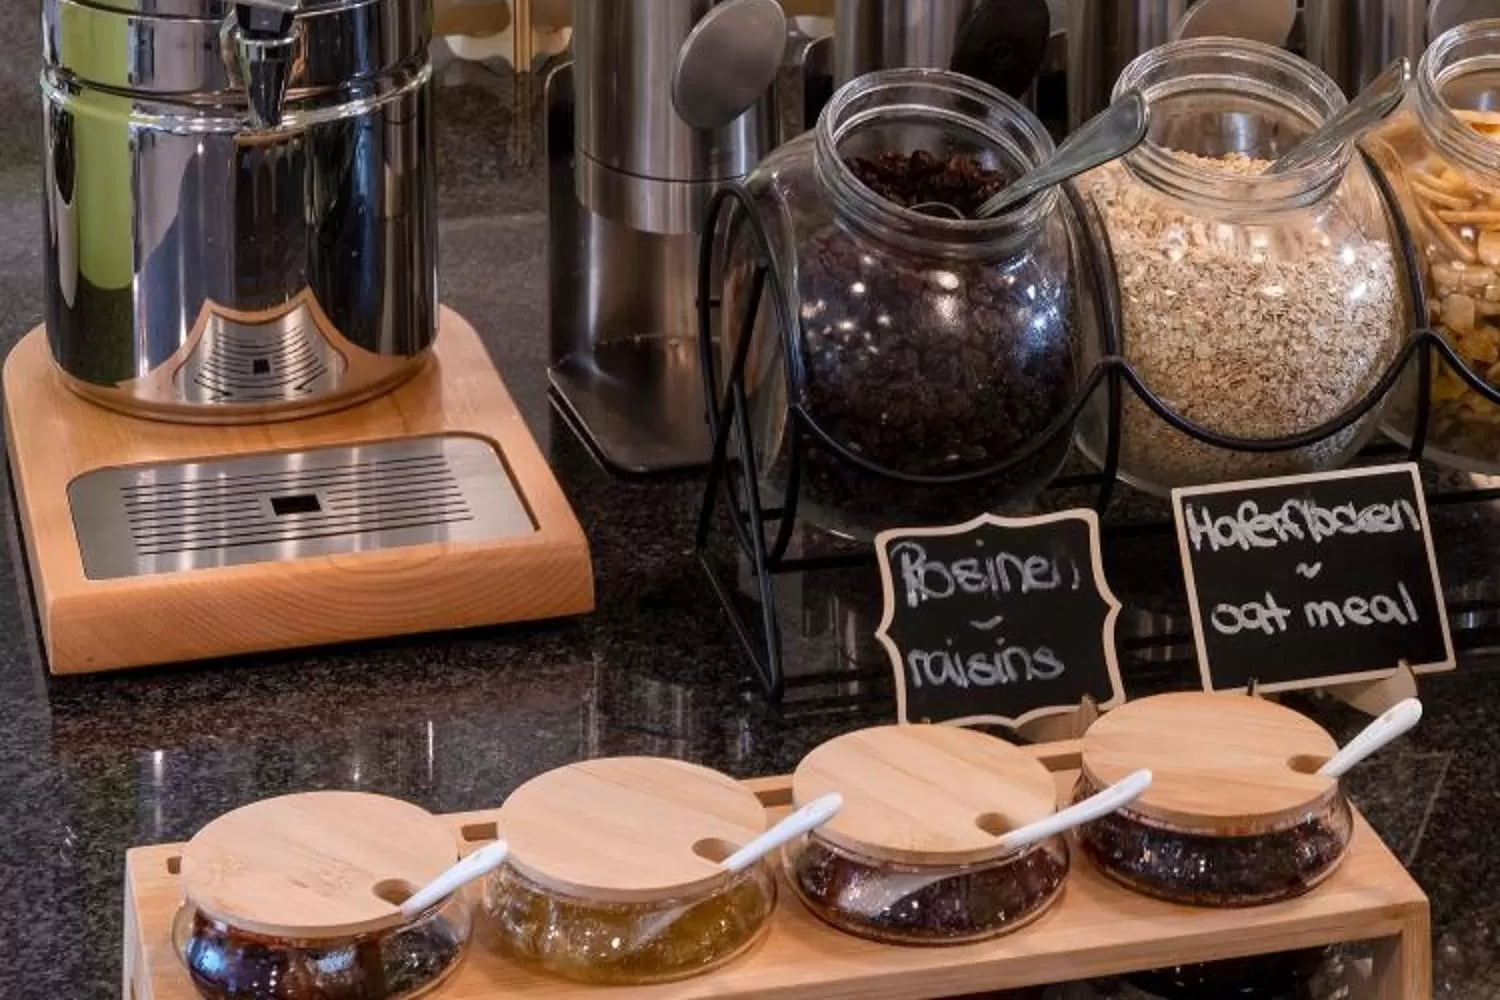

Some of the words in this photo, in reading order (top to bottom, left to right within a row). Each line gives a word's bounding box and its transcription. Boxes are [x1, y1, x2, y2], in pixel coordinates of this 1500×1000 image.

[1211, 591, 1291, 635] oat
[1303, 580, 1418, 627] meal
[908, 637, 1065, 688] raisins
